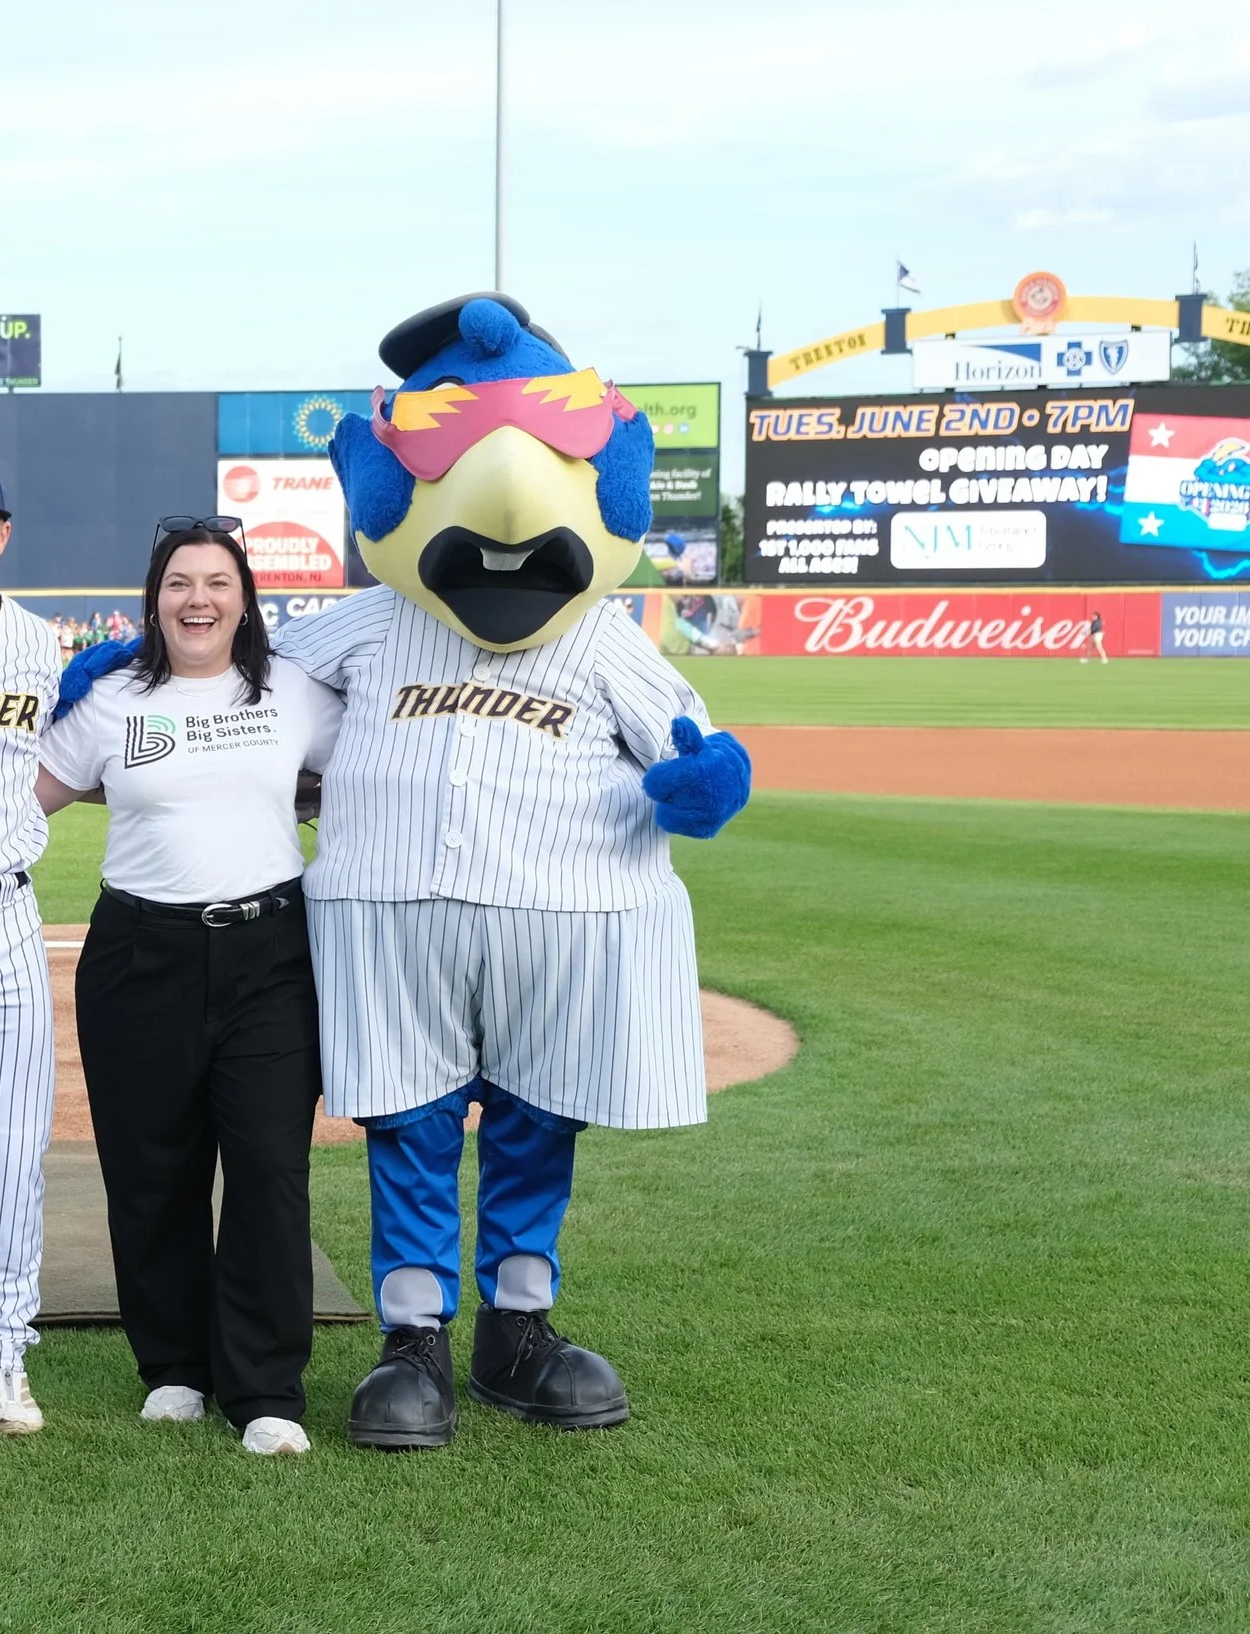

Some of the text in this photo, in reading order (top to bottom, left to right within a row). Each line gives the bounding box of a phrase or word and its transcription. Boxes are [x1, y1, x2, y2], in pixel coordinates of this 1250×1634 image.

[0, 321, 31, 340] UP.
[954, 360, 1042, 381] Horizon
[638, 402, 697, 419] lth.org
[749, 397, 1134, 441] TUES. JUNE 2ND 7PM
[1050, 444, 1109, 470] DAY
[272, 477, 335, 491] TRANE
[766, 481, 848, 507] RALLY
[948, 474, 1108, 504] GIVEAWAY!
[247, 537, 319, 554] PROUDLY
[835, 538, 880, 556] FANS
[904, 524, 972, 553] NJM
[248, 554, 332, 571] SSEMBLED
[778, 557, 809, 574] ALL
[309, 573, 322, 583] NJ
[793, 595, 1092, 654] Budweiser
[1173, 605, 1227, 626] YOUR
[1173, 627, 1227, 648] YOUR
[185, 708, 278, 729] Big Brothers
[390, 681, 573, 741] THUNDER
[186, 723, 271, 743] Big Sisters
[188, 738, 279, 754] OF MERCER COUNTY
